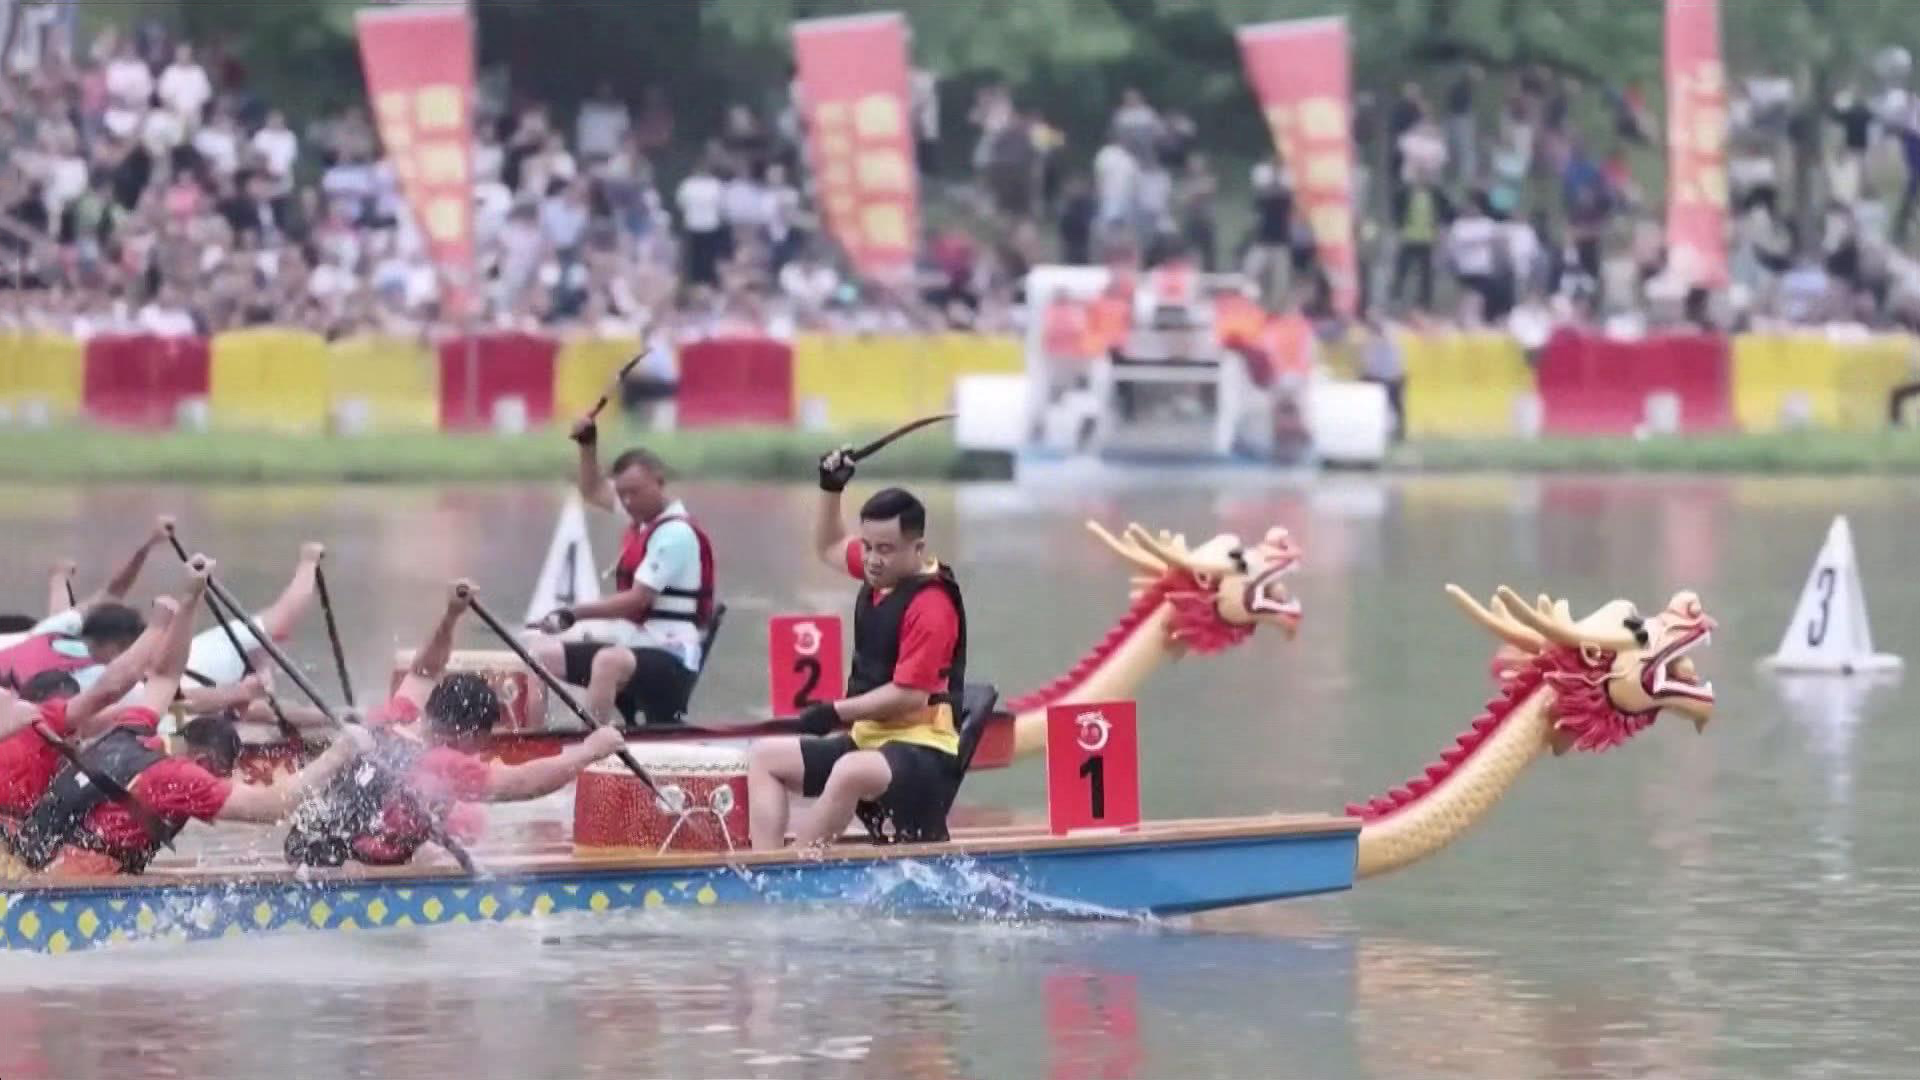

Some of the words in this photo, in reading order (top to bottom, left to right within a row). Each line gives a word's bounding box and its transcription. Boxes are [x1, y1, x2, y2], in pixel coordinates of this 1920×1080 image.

[1808, 567, 1836, 646] 3
[793, 657, 822, 709] 2
[1079, 755, 1105, 819] 1
